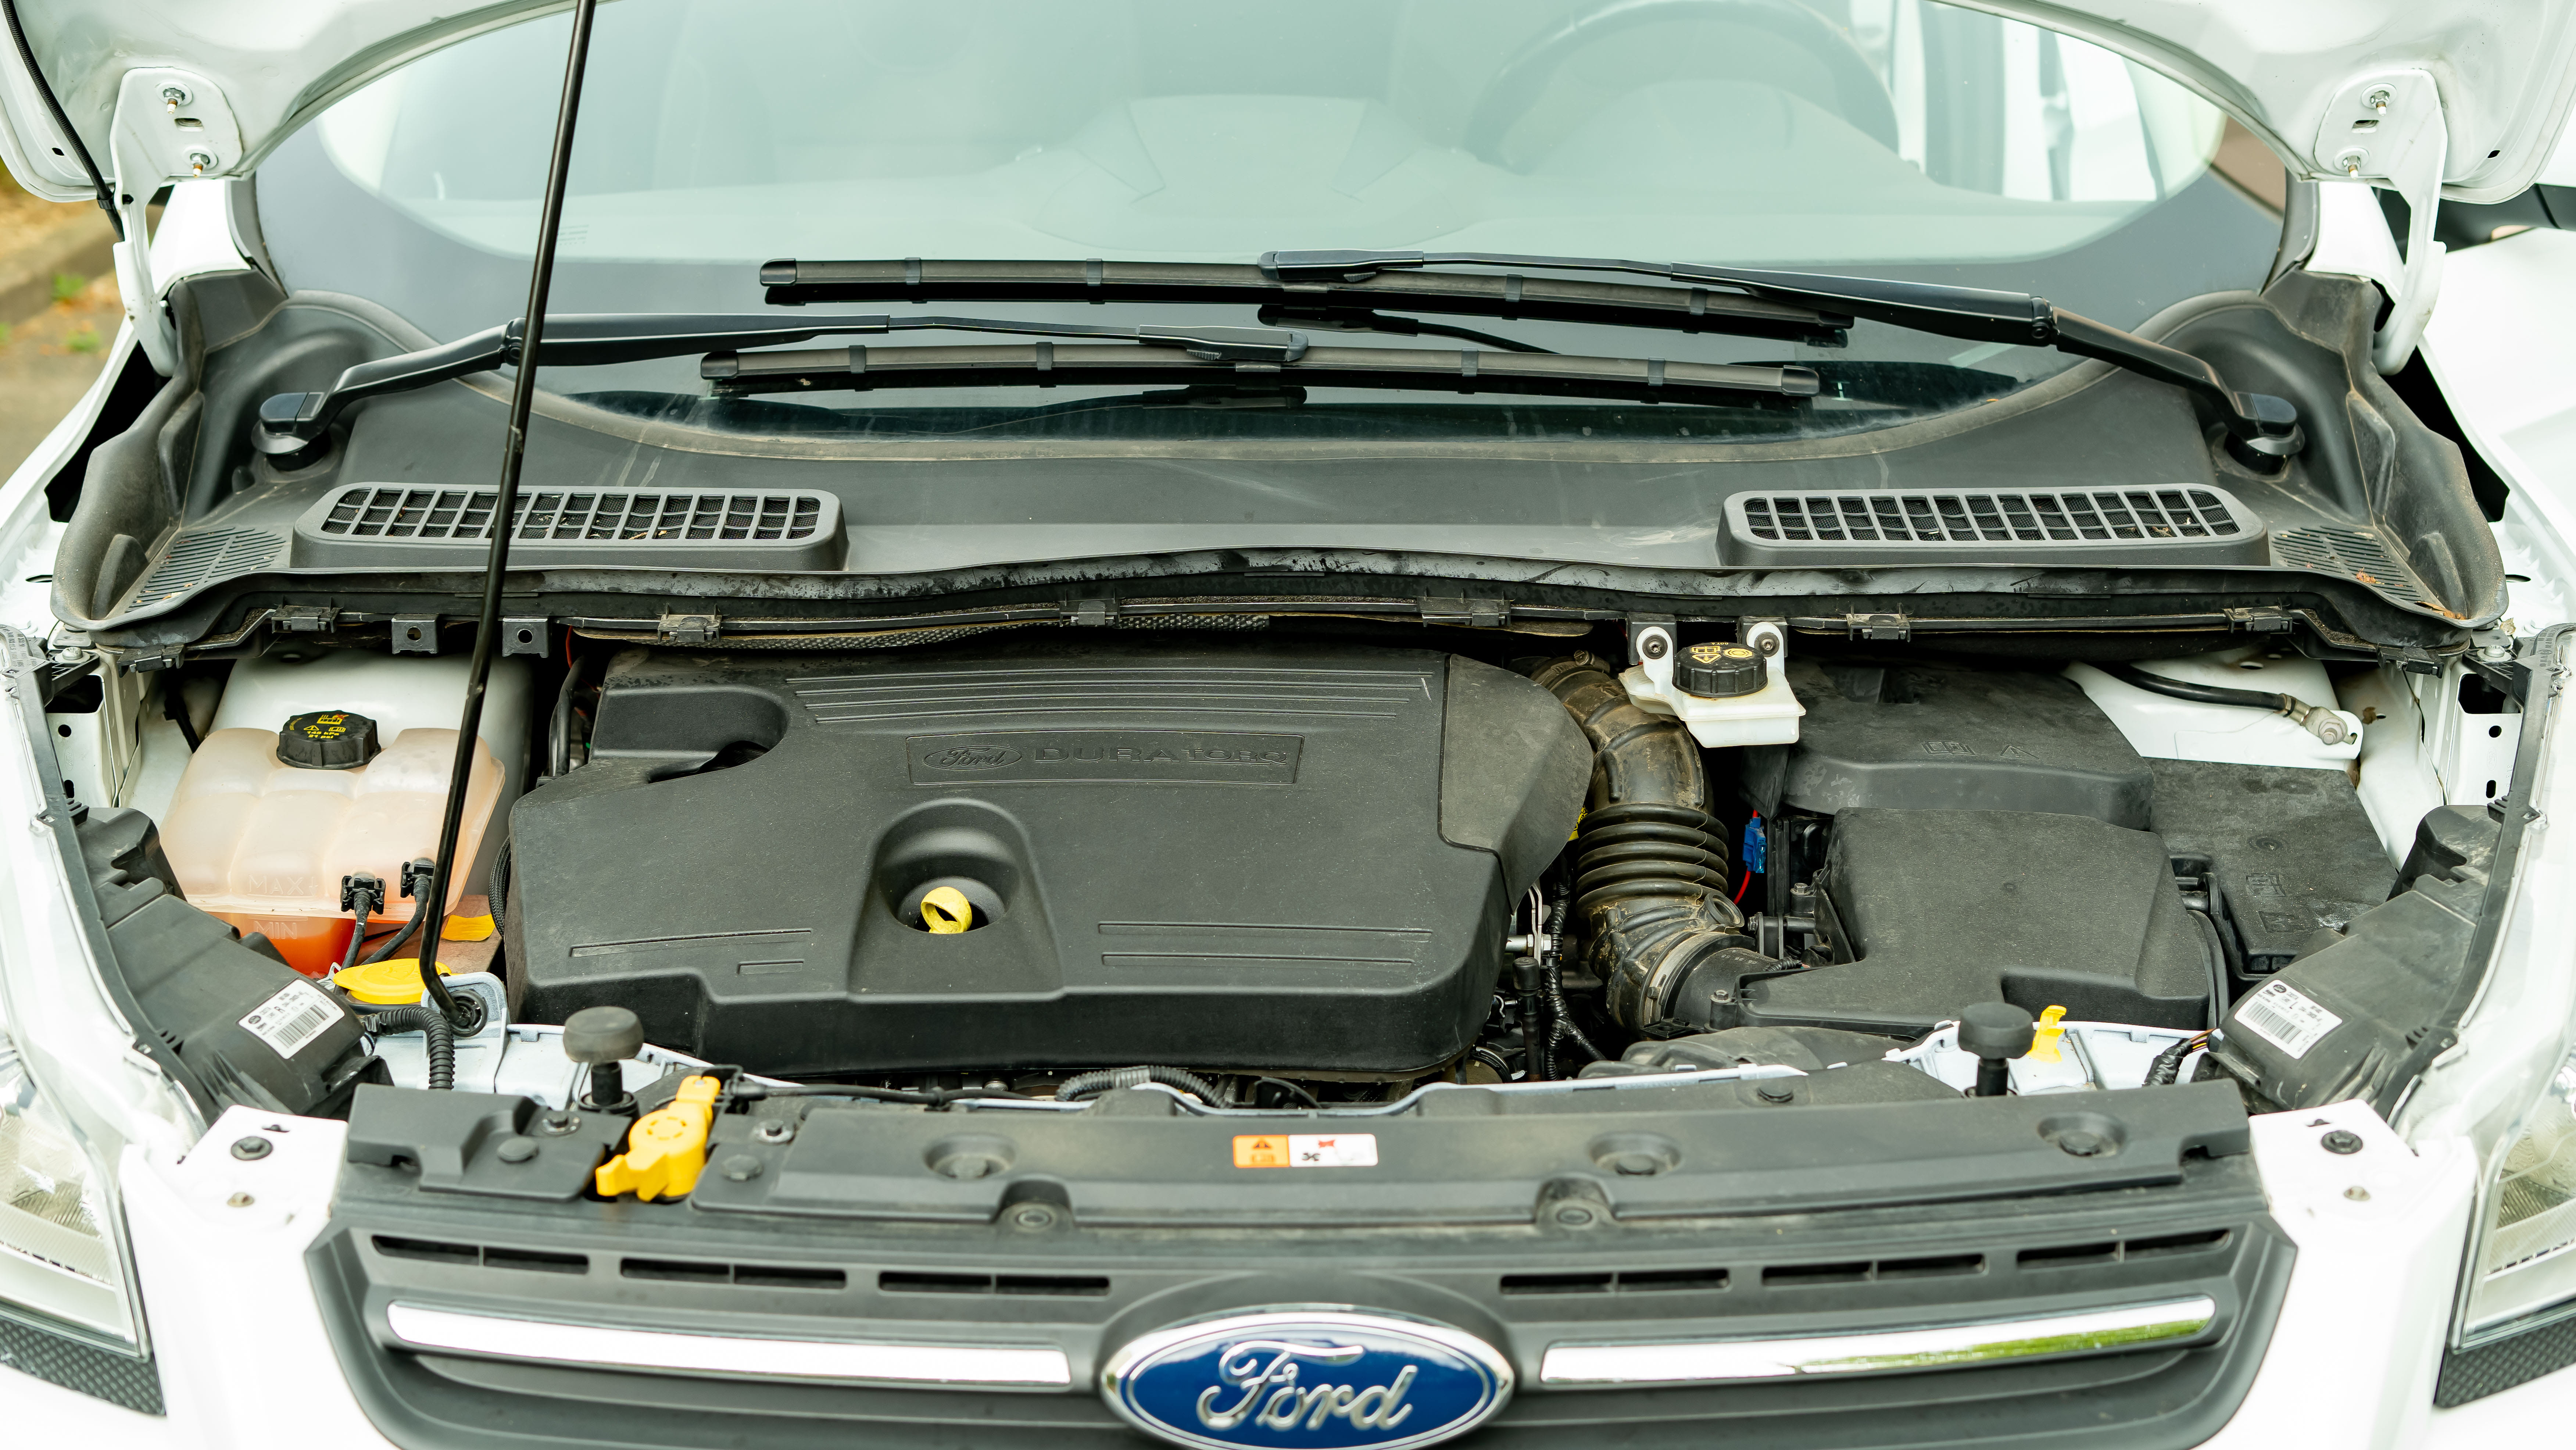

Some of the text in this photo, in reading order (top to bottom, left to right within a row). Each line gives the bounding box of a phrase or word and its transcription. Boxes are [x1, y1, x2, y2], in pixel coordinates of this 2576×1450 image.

[939, 747, 1287, 766] Ford DURATORQ
[247, 874, 304, 895] MAX
[254, 921, 297, 939] MIN
[1196, 1340, 1418, 1430] Ford
